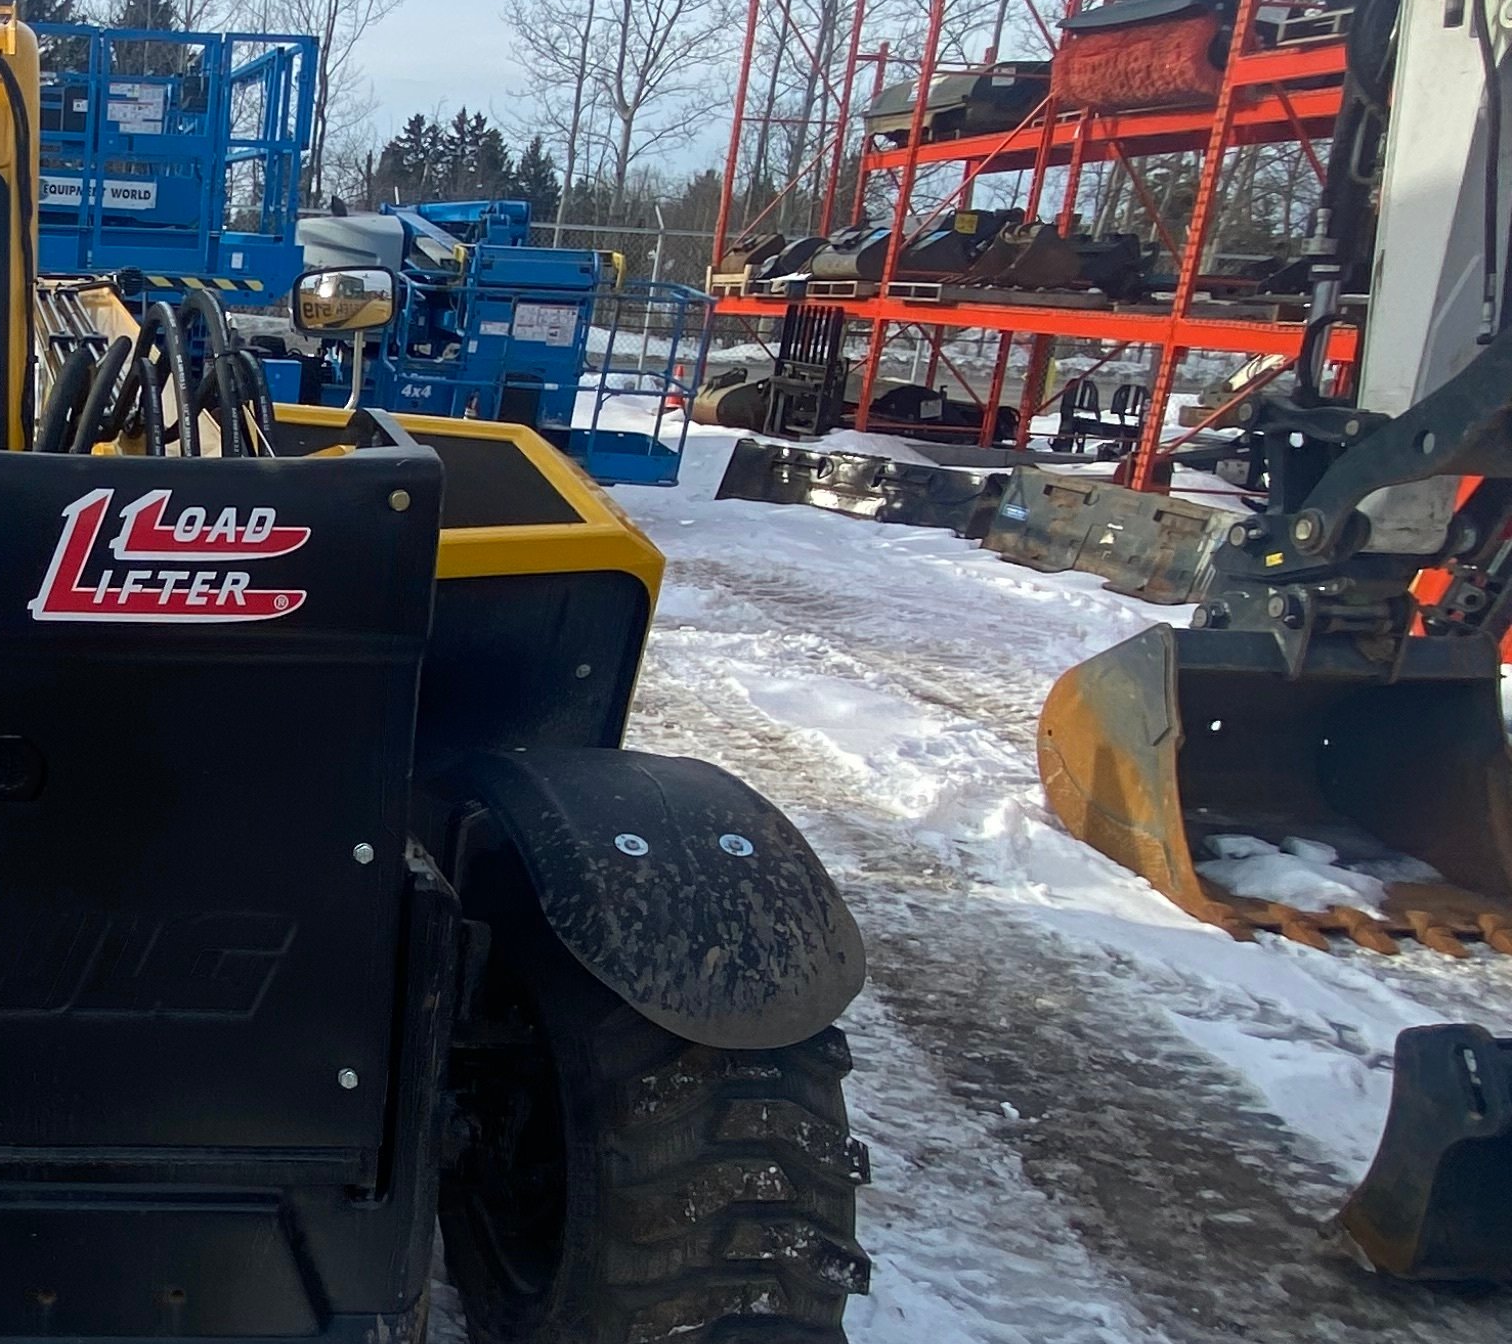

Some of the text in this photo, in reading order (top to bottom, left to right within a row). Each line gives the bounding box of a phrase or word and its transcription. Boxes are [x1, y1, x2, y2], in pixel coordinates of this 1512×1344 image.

[111, 187, 151, 201] WORLD
[401, 384, 432, 398] 4x4
[109, 490, 311, 562] LOAD
[27, 489, 307, 623] LIFTER
